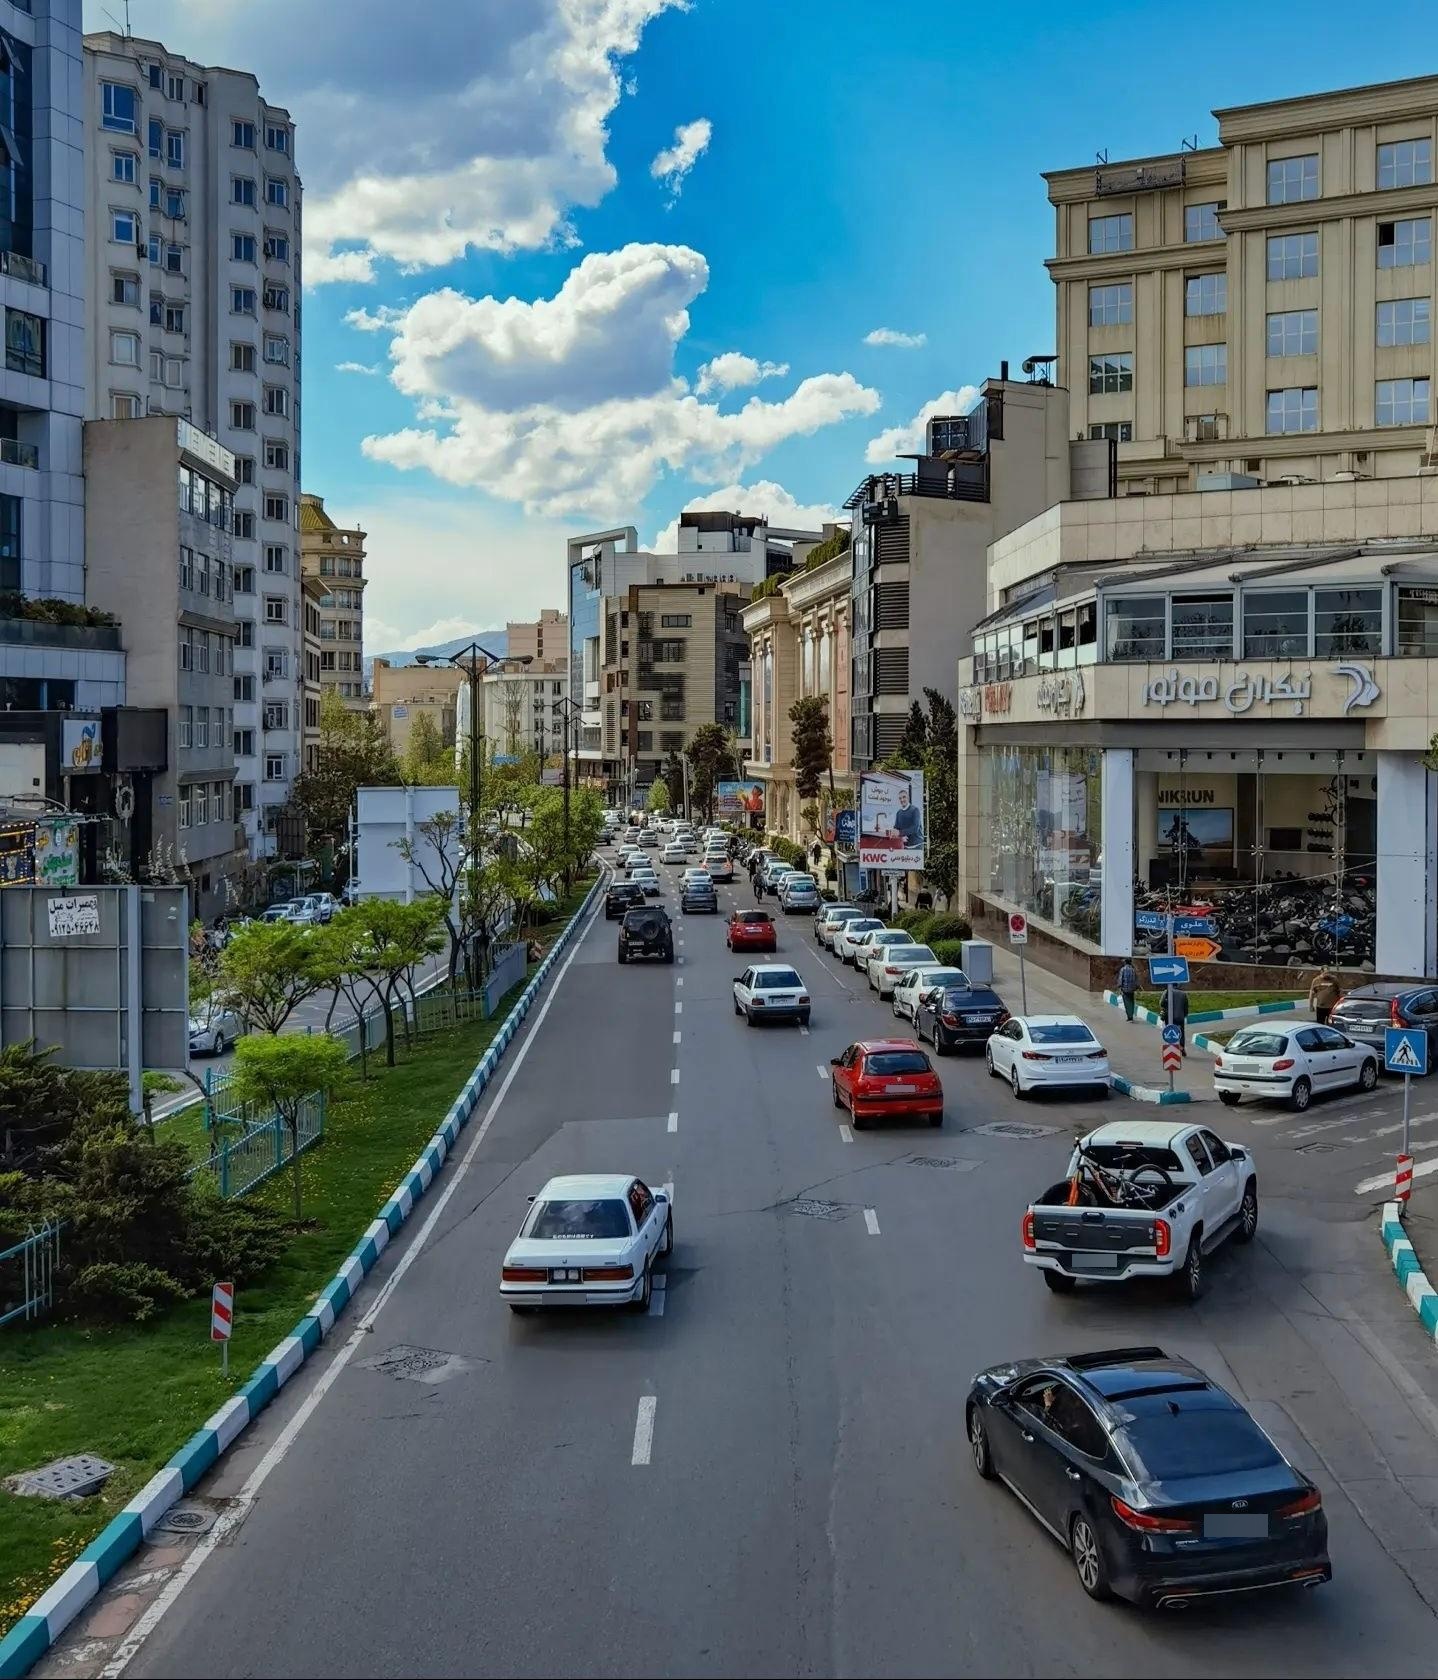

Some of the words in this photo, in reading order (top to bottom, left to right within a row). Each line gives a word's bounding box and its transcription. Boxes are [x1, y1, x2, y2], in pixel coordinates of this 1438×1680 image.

[1143, 667, 1218, 706] موتور
[1225, 669, 1311, 715] نیکران
[863, 854, 887, 862] KWC
[66, 896, 97, 913] تعمیرات
[1180, 920, 1203, 929] علوی
